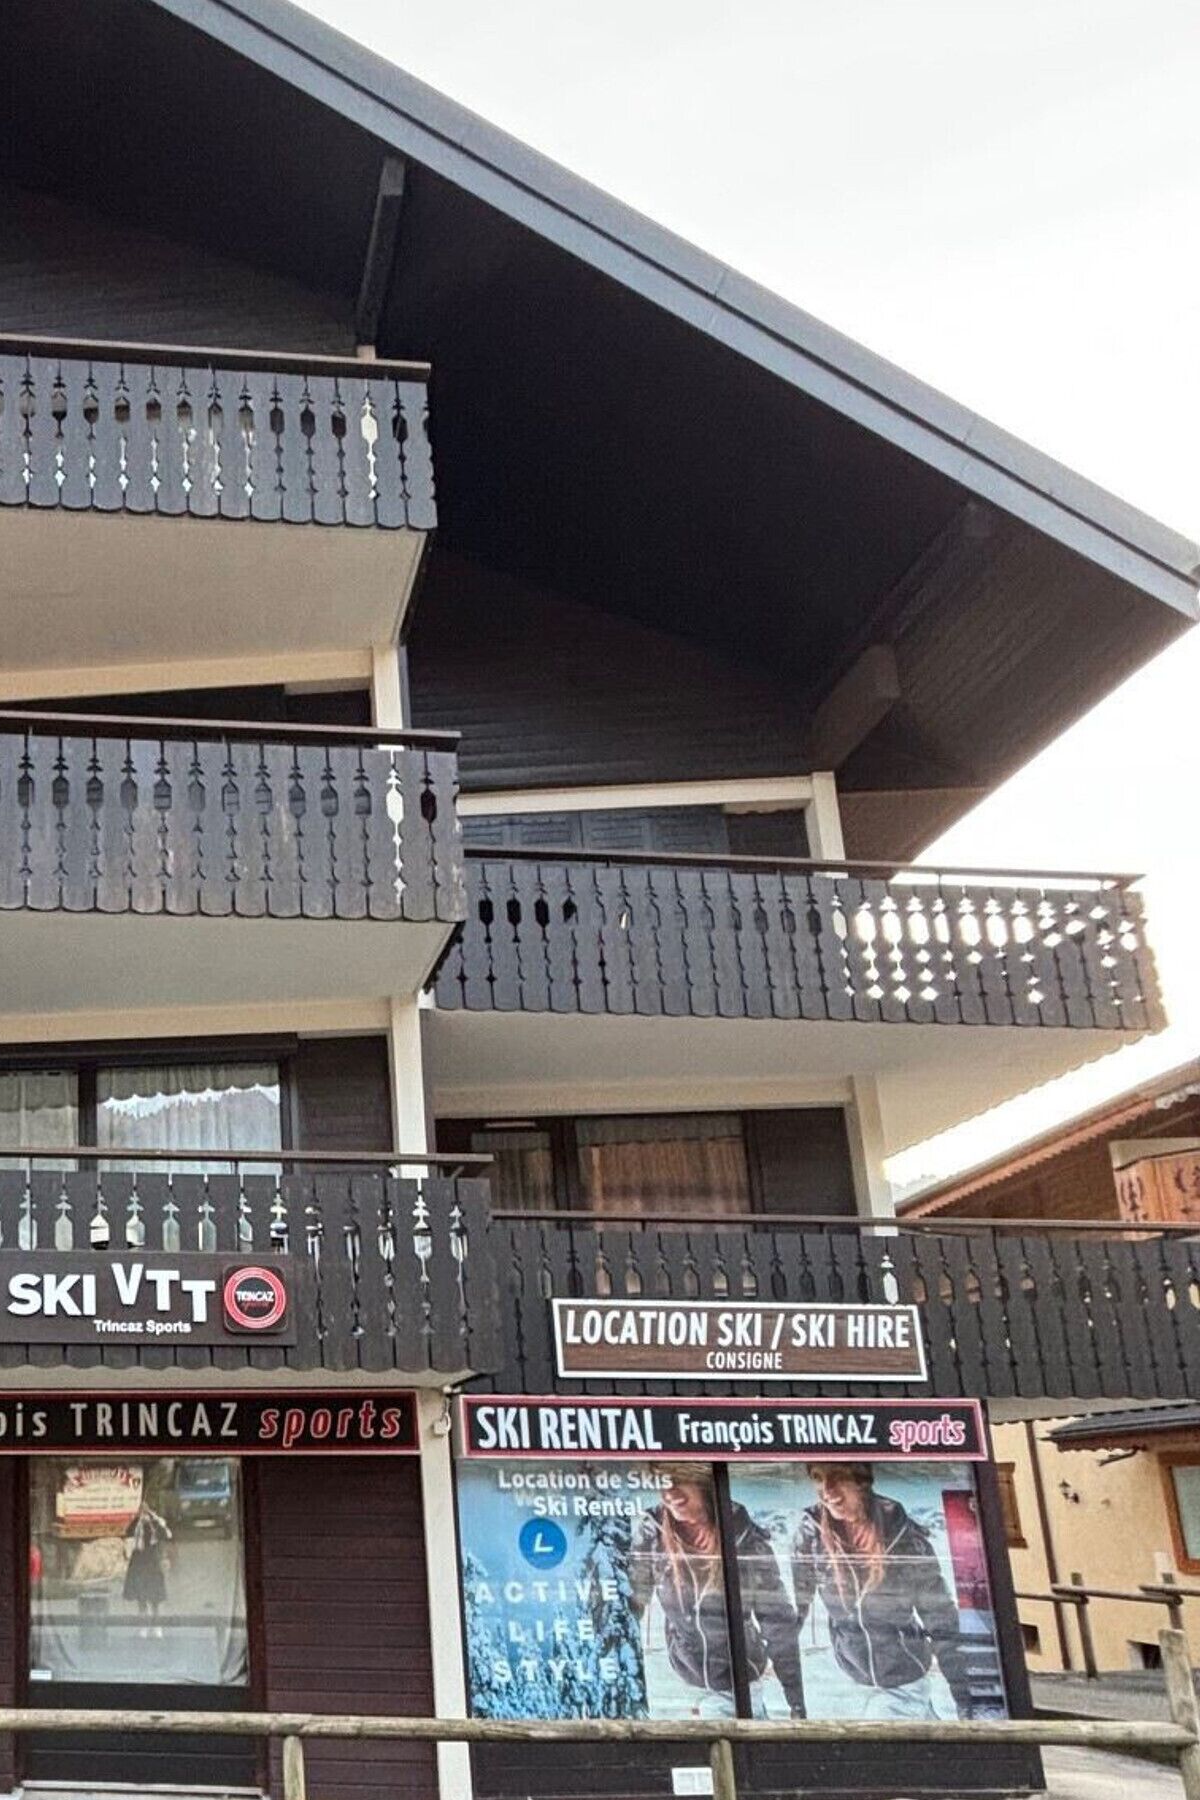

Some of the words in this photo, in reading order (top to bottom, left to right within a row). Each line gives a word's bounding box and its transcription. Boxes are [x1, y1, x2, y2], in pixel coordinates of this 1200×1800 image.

[7, 1273, 97, 1316] SKI
[111, 1263, 216, 1323] VTT
[93, 1320, 143, 1333] Trincaz
[146, 1320, 191, 1335] Sports
[566, 1310, 707, 1346] LOCATION
[717, 1312, 763, 1347] SKI
[791, 1313, 835, 1348] SKI
[847, 1314, 910, 1349] HIRE
[706, 1351, 782, 1370] CONSIGNE
[70, 1402, 238, 1437] TRINCAZ
[258, 1400, 401, 1448] sports
[476, 1406, 531, 1449] SKI
[539, 1408, 663, 1450] RENTAL
[678, 1413, 774, 1451] François
[777, 1414, 877, 1444] TRINCAZ
[889, 1414, 966, 1452] sports
[499, 1469, 590, 1490] Location
[595, 1470, 622, 1490] de
[627, 1470, 674, 1490] Skis
[533, 1496, 567, 1517] Ski
[574, 1496, 648, 1517] Rental
[476, 1579, 619, 1604] ACTIVE
[508, 1619, 595, 1643] LIFE
[493, 1657, 620, 1683] STYLE
